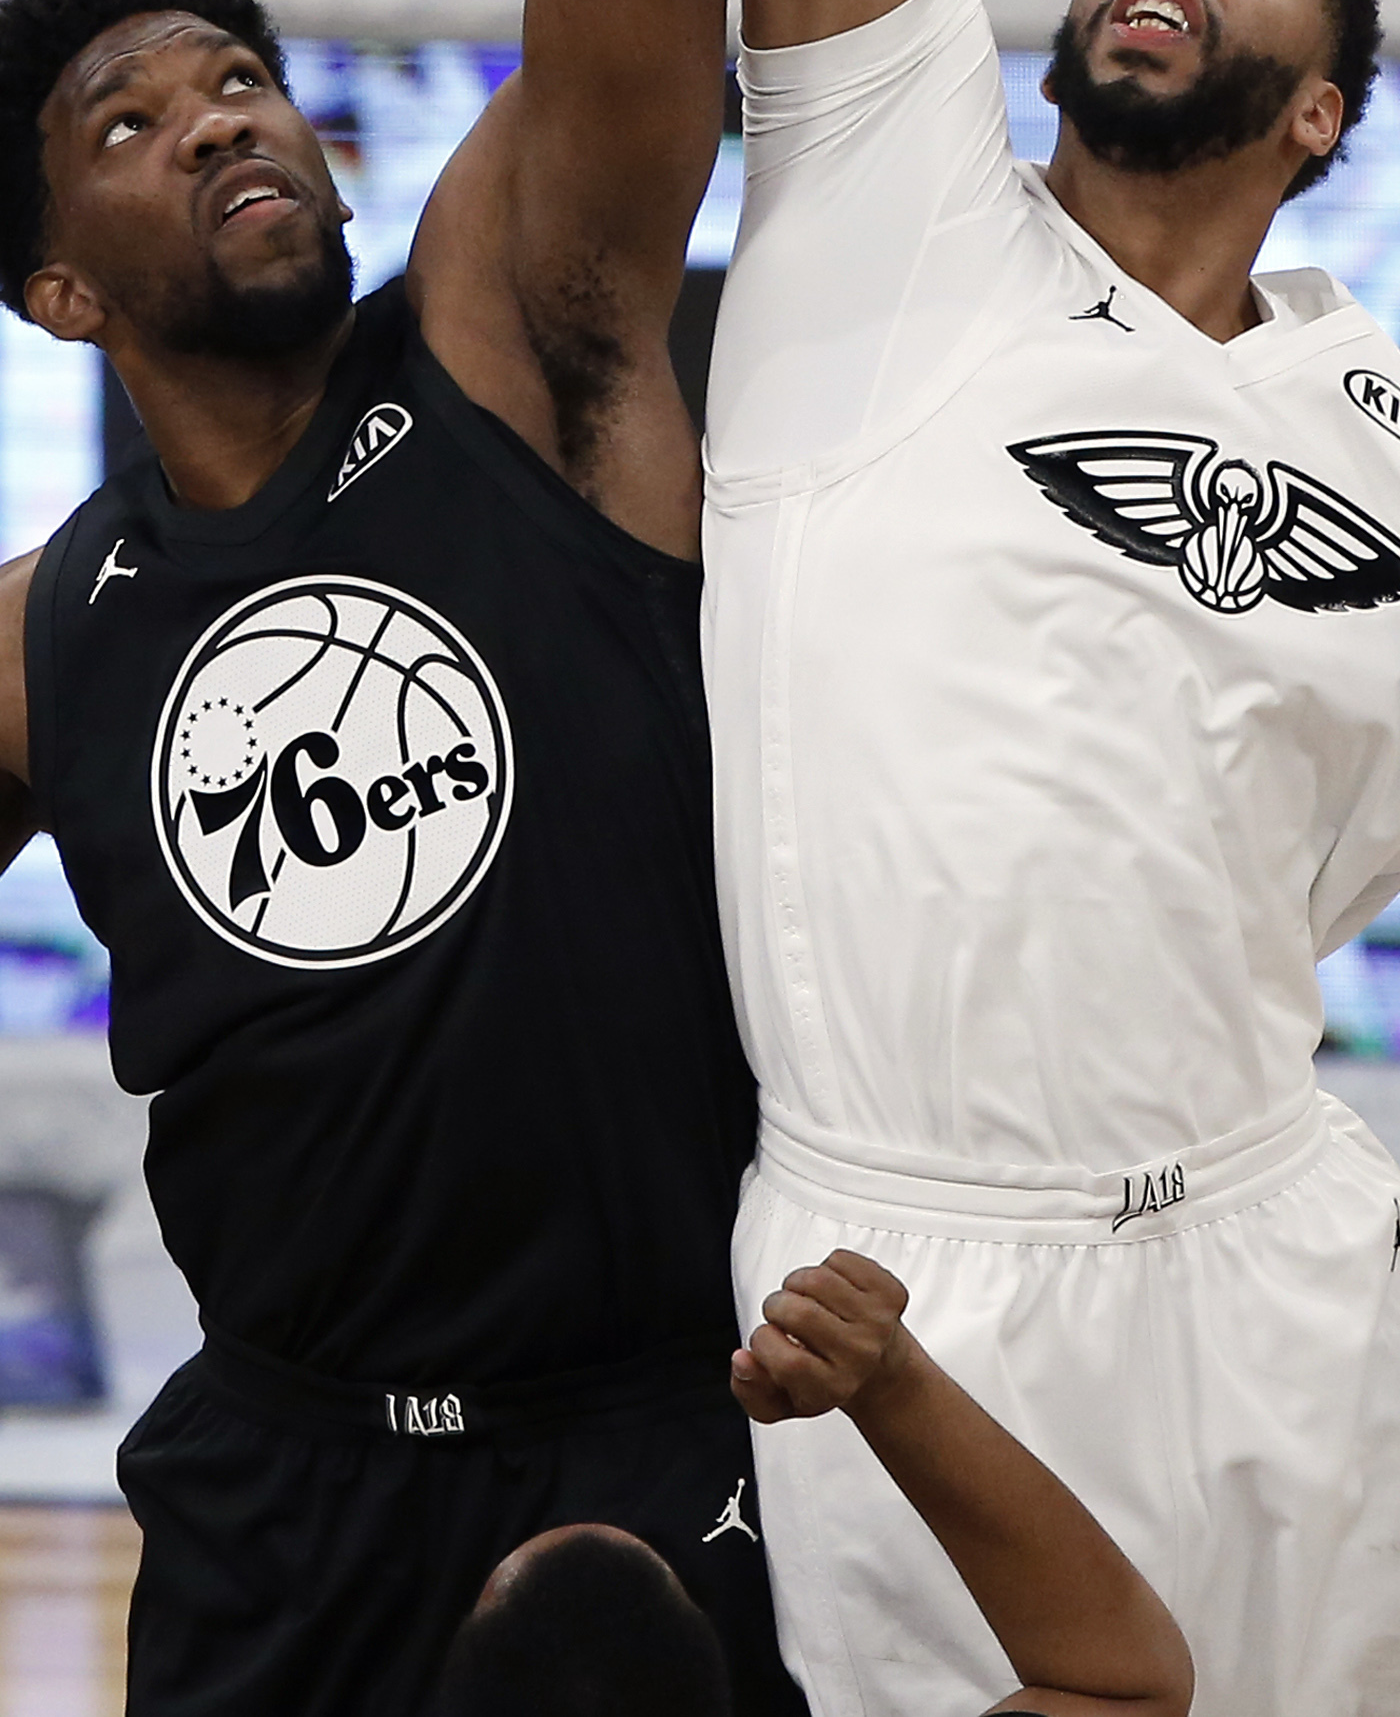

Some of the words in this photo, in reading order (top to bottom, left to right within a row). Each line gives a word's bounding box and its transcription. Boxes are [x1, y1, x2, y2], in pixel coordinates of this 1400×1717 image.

[338, 415, 398, 487] KIA
[188, 729, 490, 914] 76ers
[1111, 1162, 1186, 1235] LA18
